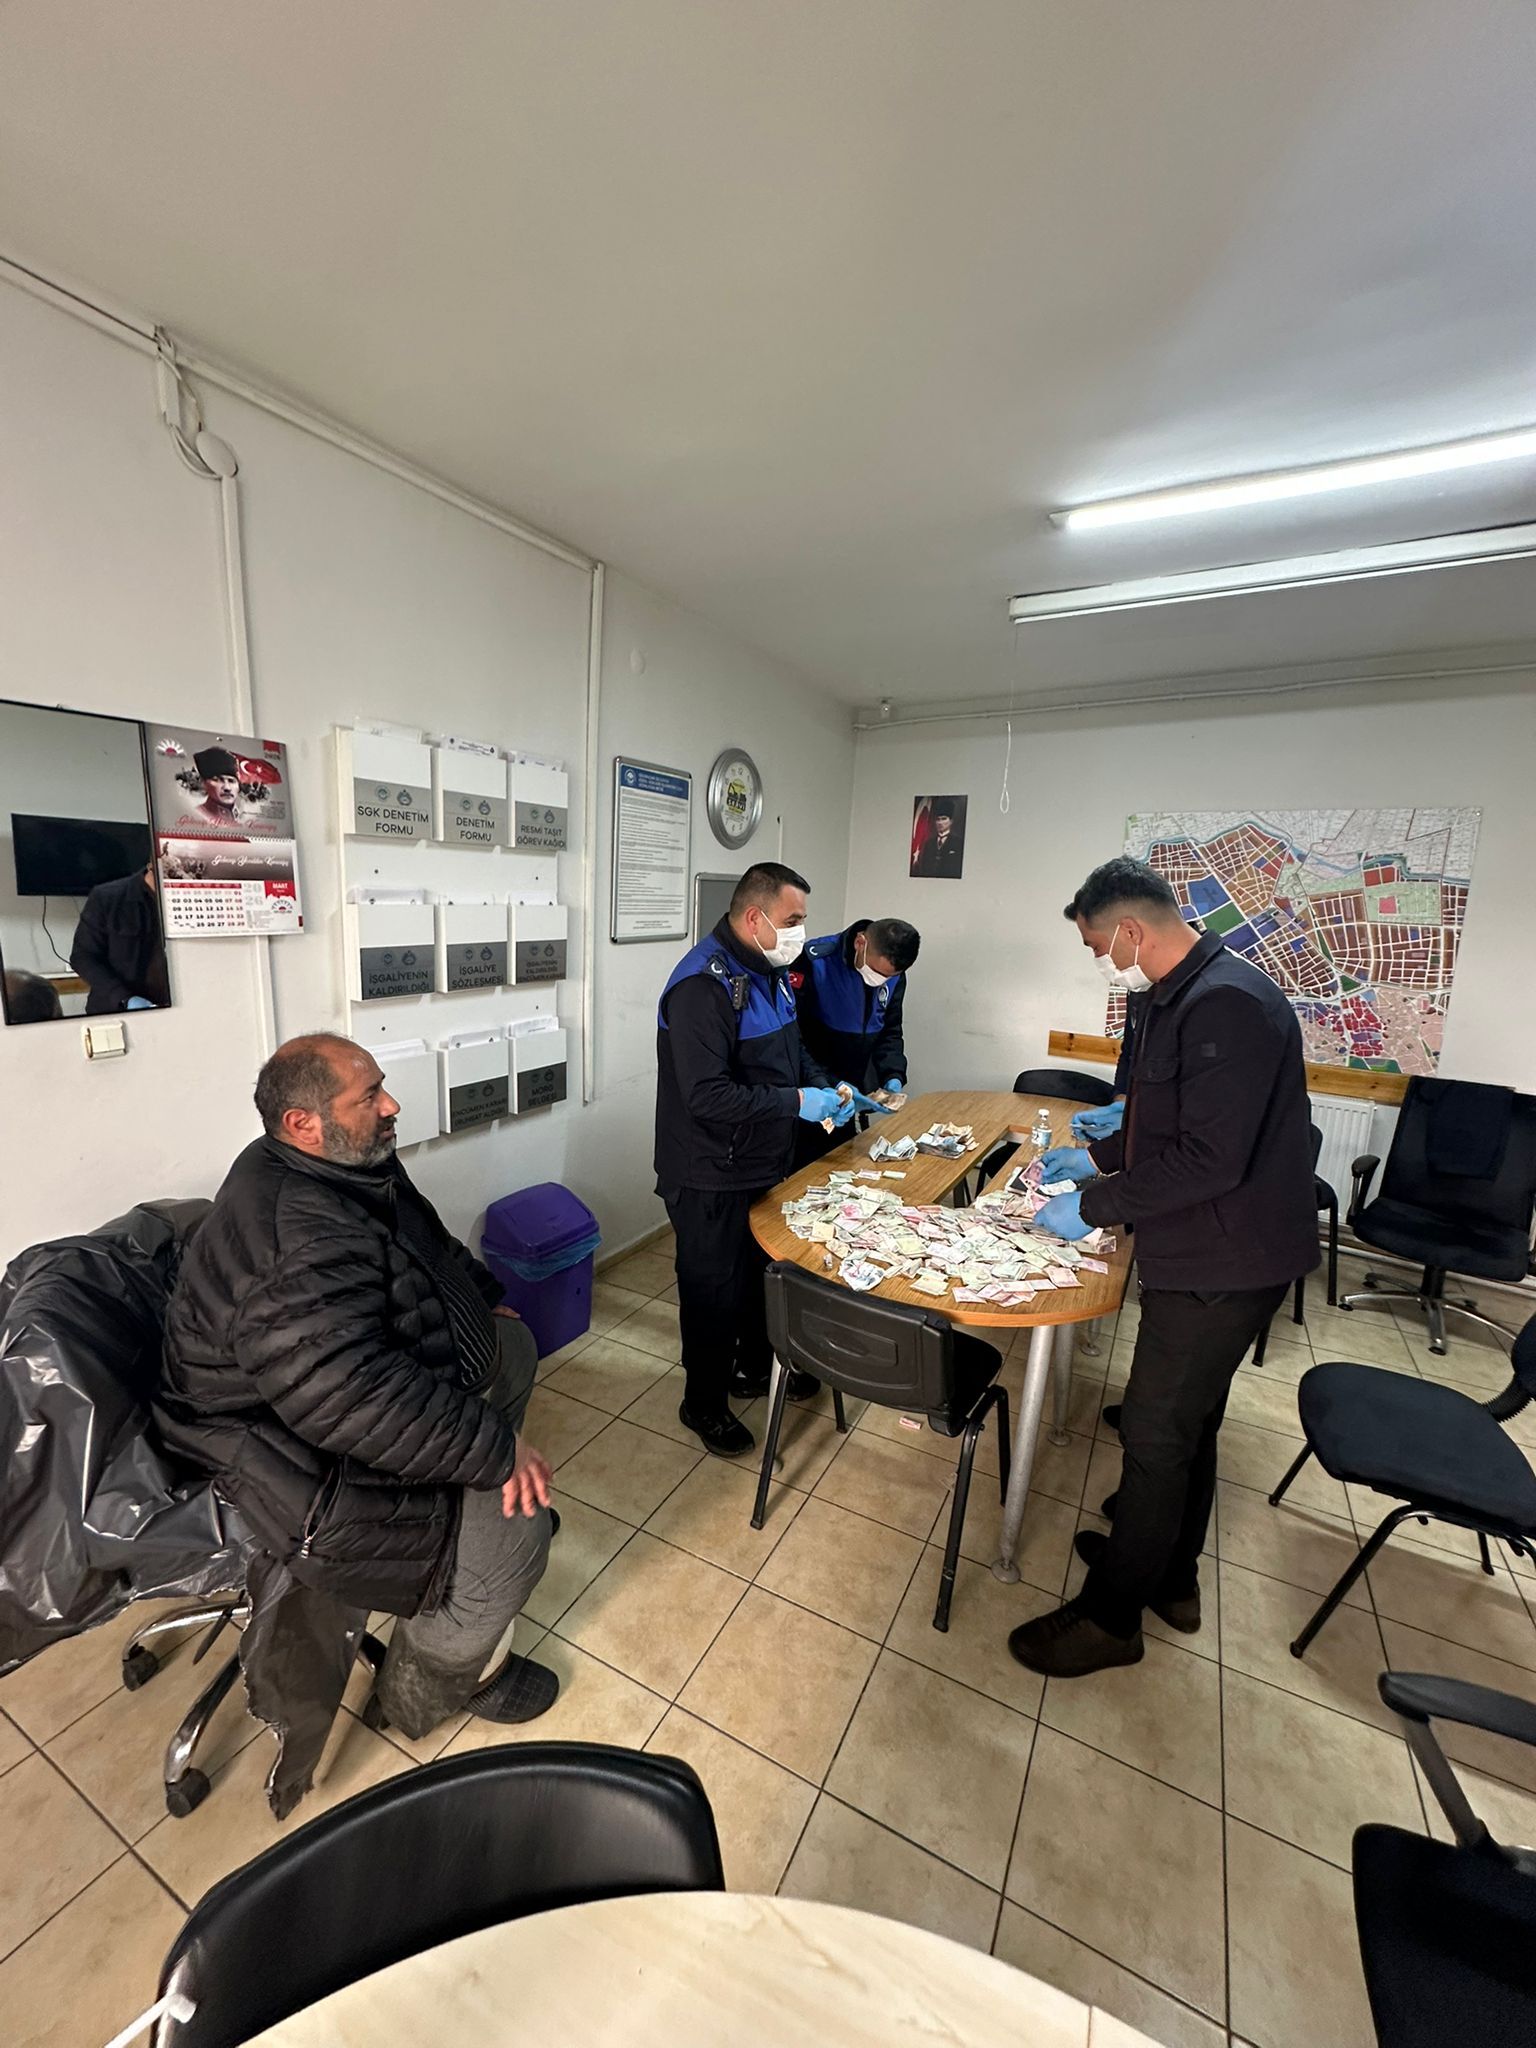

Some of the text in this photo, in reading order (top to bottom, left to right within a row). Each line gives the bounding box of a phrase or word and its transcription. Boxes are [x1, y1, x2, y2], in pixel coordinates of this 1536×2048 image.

[358, 806, 429, 823] SGK DENETİM
[375, 822, 414, 836] FORMU
[456, 816, 495, 830] DENETİM
[460, 830, 492, 842] FORMU
[459, 964, 497, 976] İŞGALİYE
[452, 975, 504, 989] SÖZLEŞMESİ
